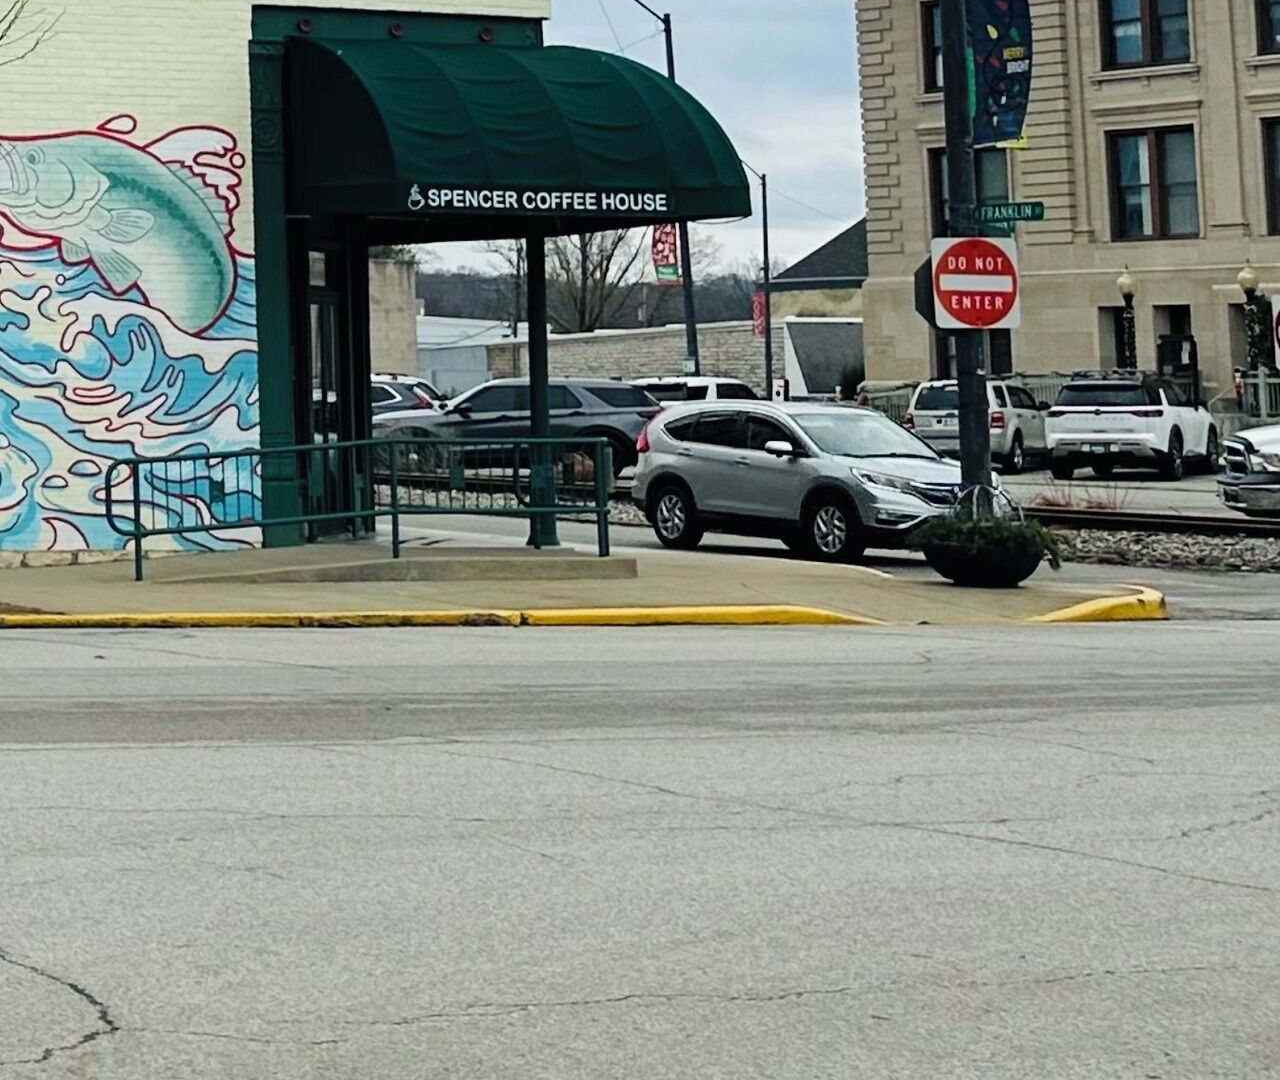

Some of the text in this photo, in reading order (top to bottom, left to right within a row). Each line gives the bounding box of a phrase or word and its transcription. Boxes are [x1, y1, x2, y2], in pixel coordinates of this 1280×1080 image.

[427, 188, 668, 212] SPENCER COFFEE HOUSE
[981, 204, 1032, 220] FRANKLIN
[947, 256, 1004, 271] DO NOT
[951, 295, 1004, 310] ENTER
